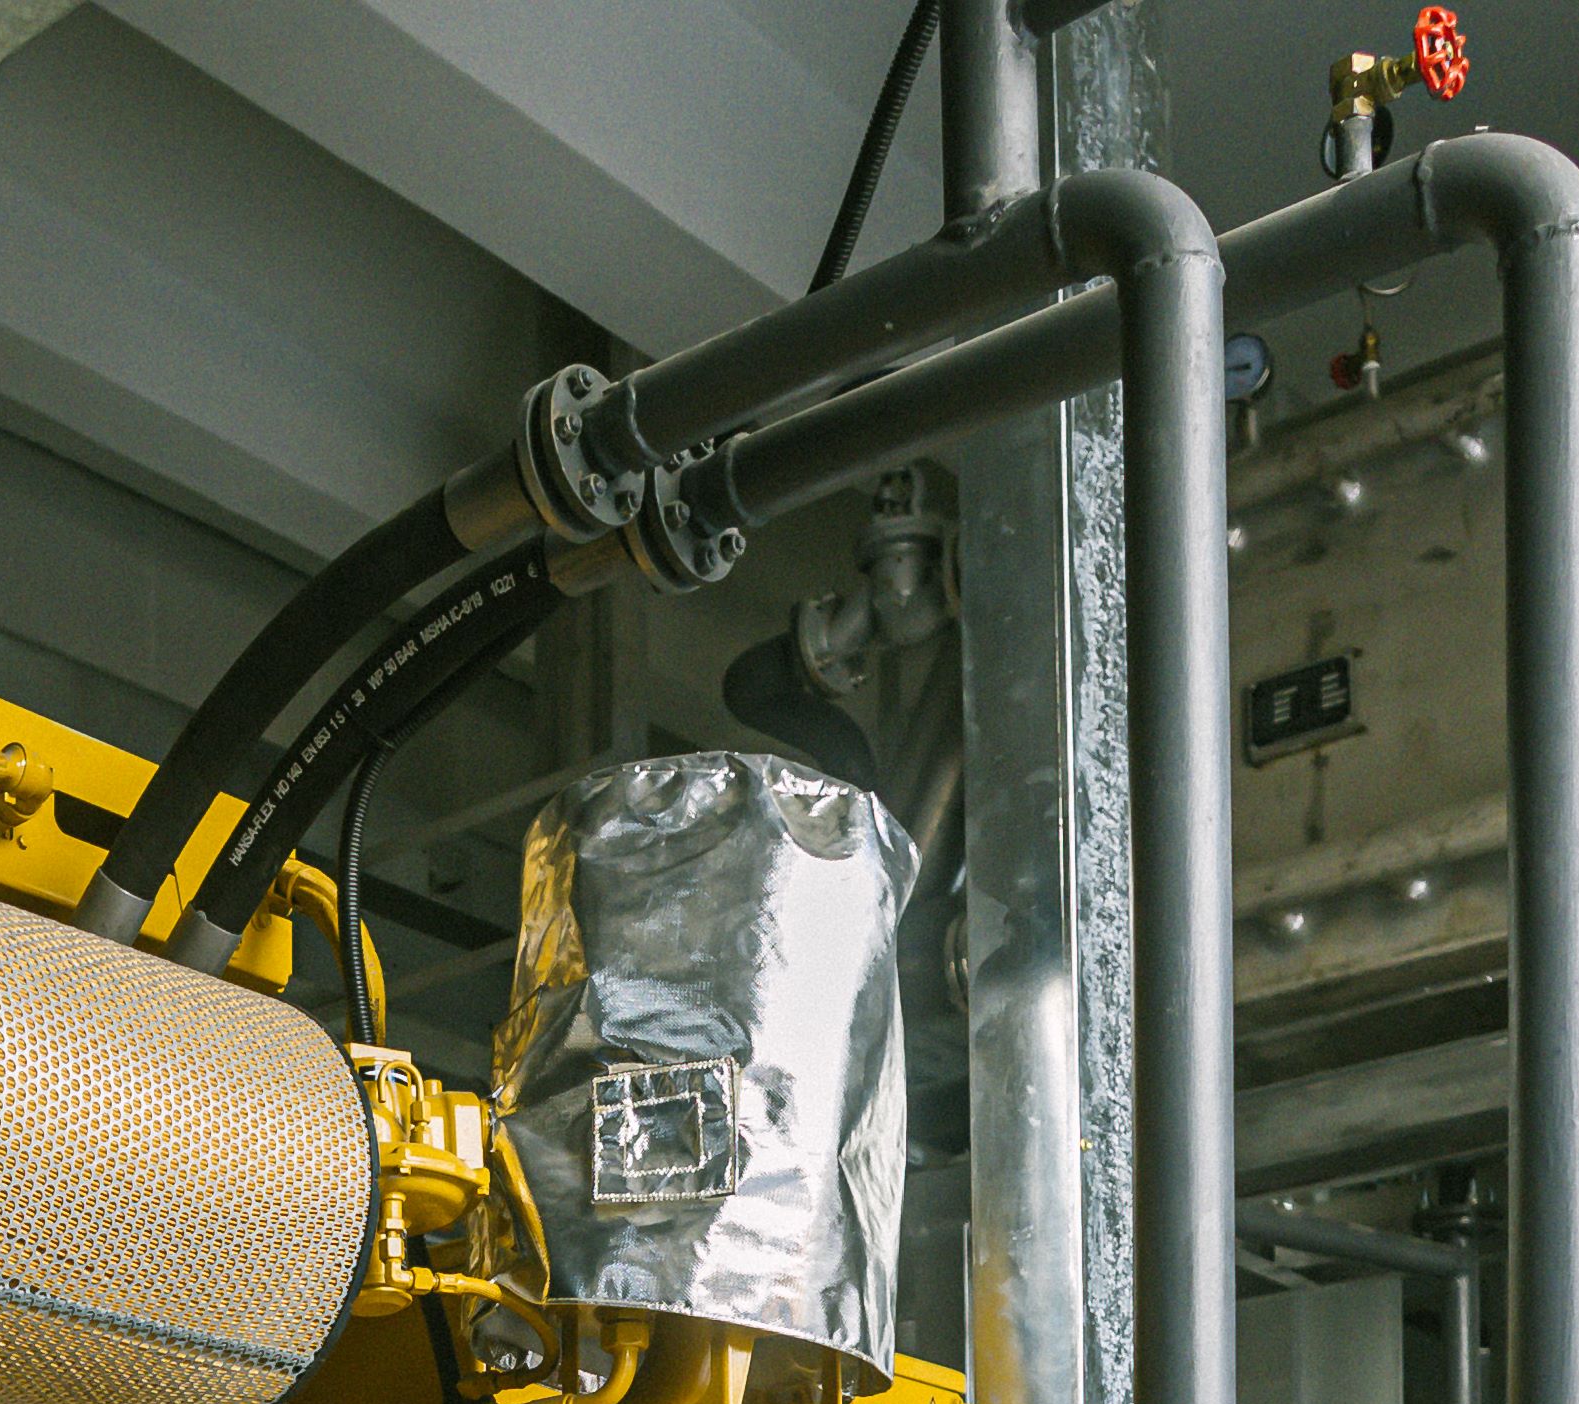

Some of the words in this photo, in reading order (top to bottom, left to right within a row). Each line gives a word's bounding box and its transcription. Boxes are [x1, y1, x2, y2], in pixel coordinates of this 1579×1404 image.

[229, 798, 277, 867] HANSA-FLEX
[273, 779, 290, 799] HD
[301, 744, 318, 764] EN
[367, 669, 384, 690] WP
[395, 639, 419, 666] BAR
[491, 573, 516, 597] 1Q21
